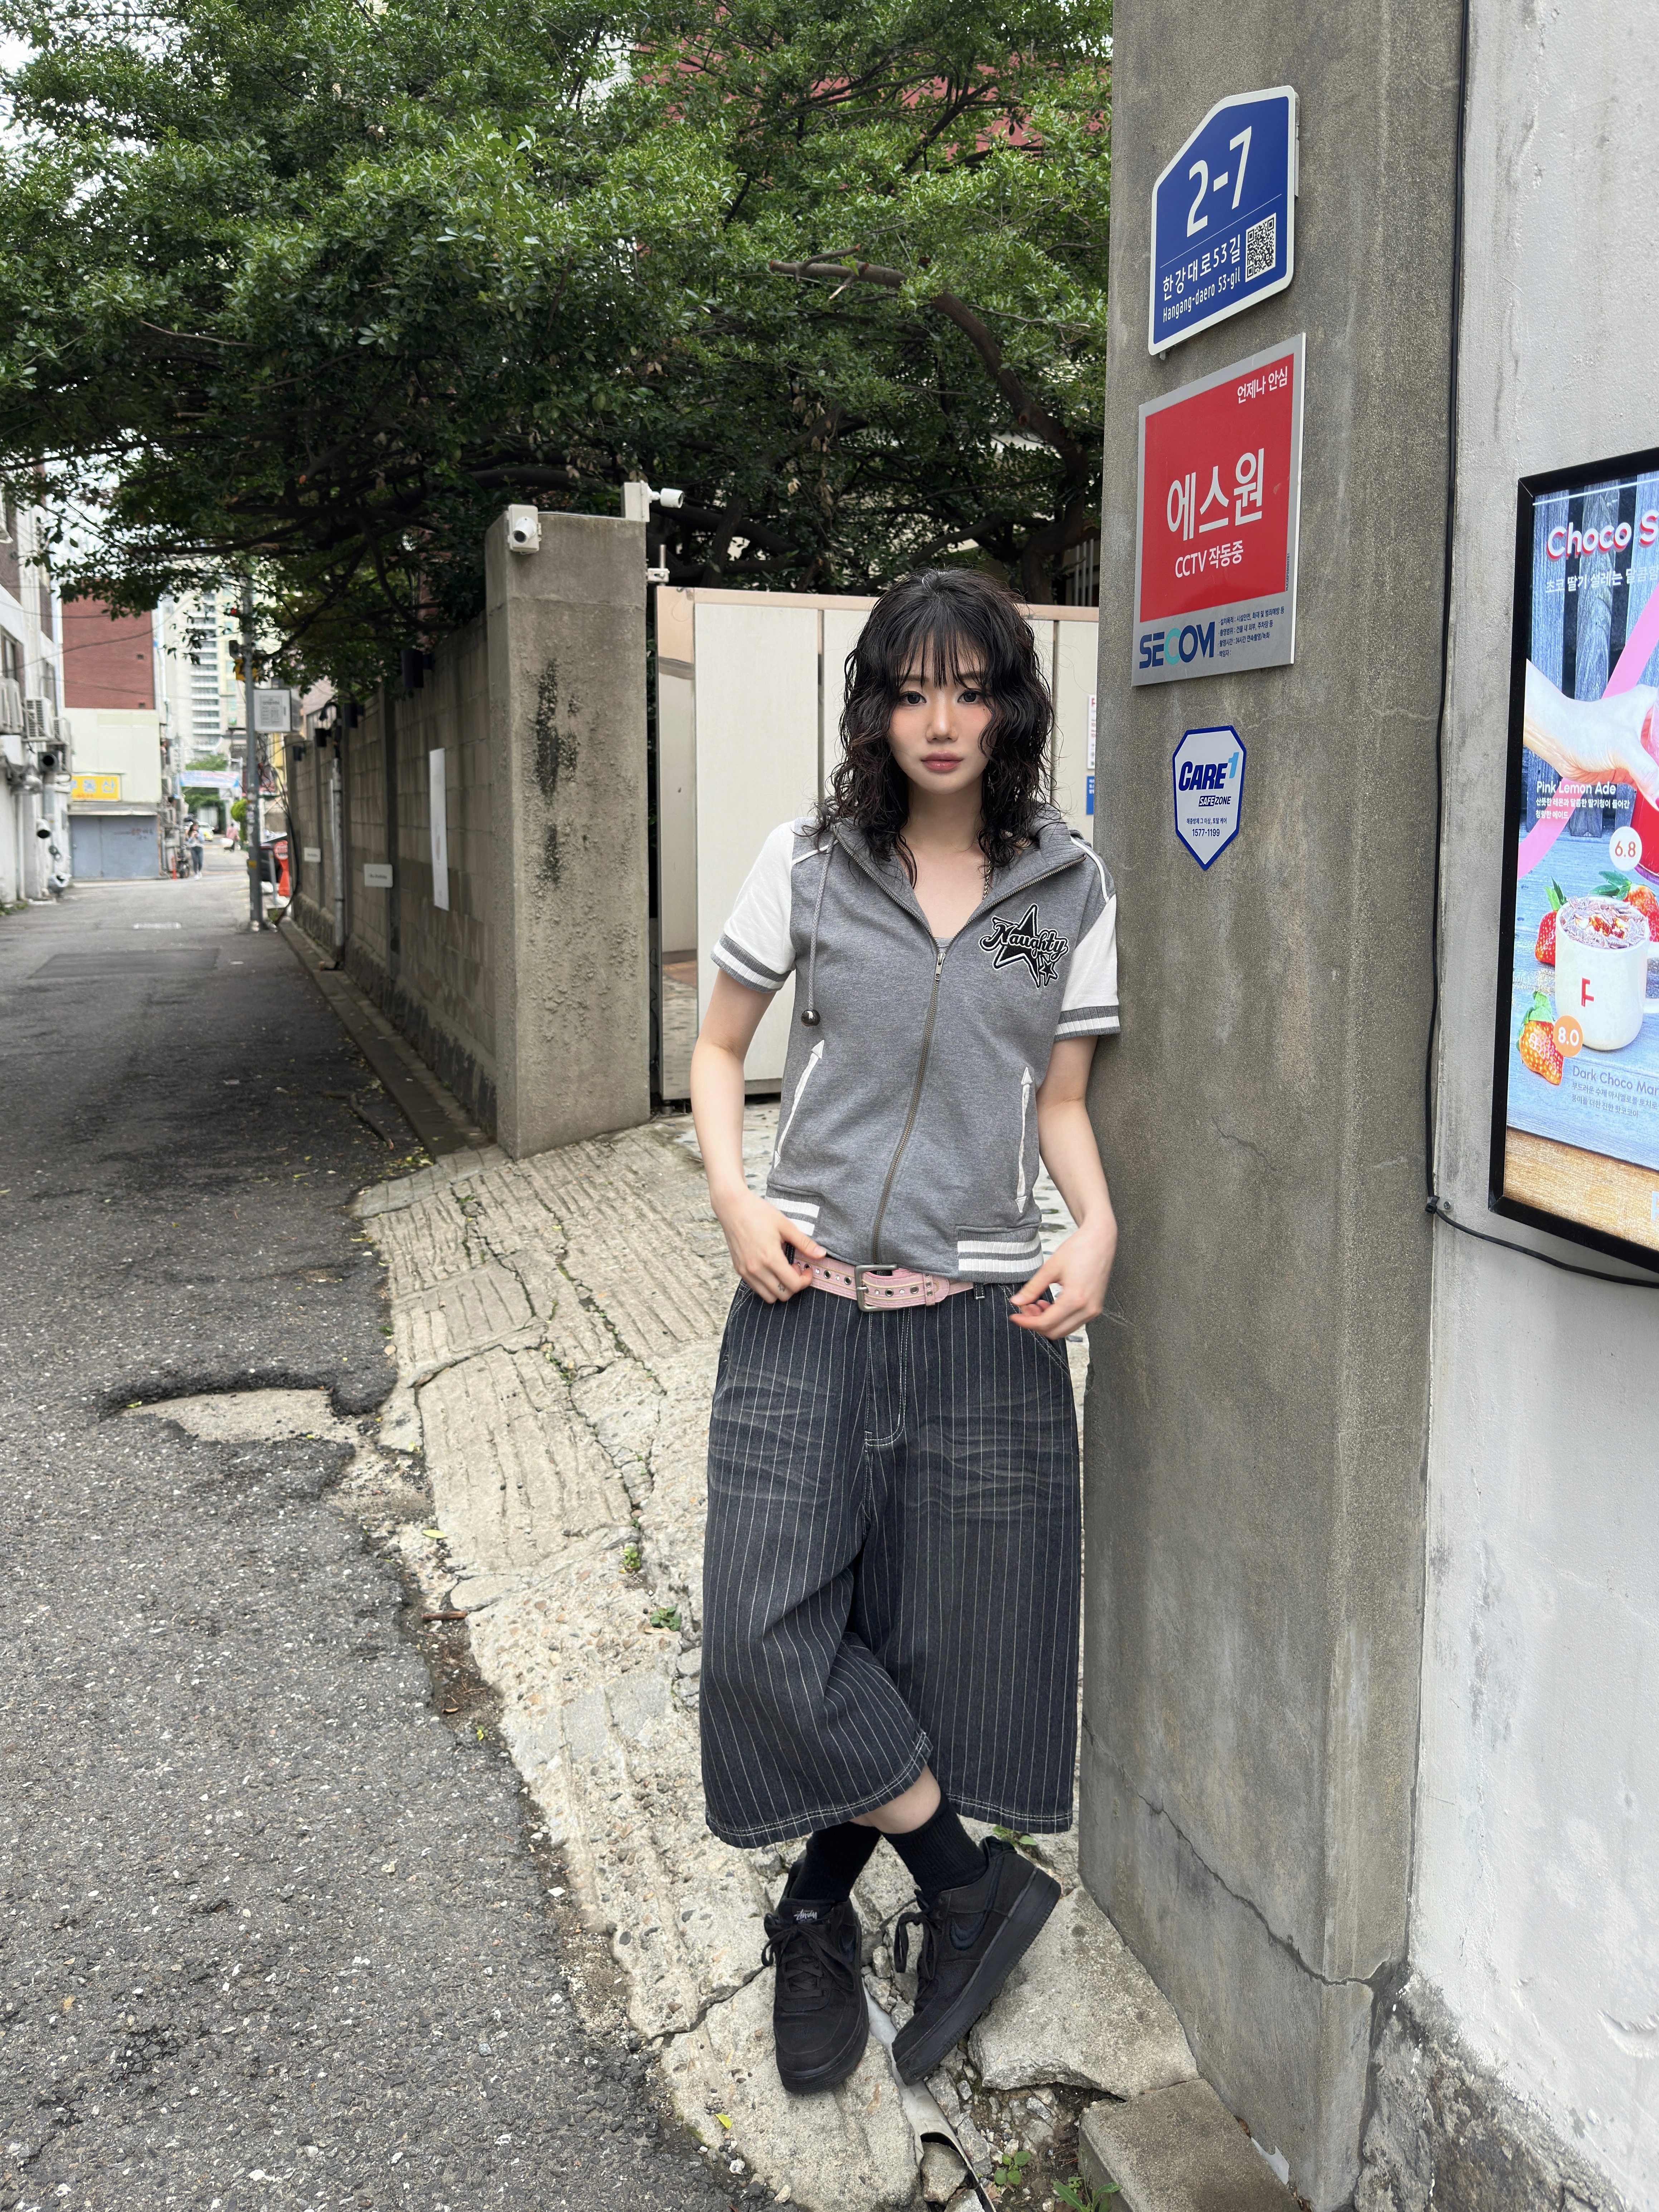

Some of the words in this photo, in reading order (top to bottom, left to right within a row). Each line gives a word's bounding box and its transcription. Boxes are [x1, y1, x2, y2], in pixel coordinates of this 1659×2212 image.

[1187, 126, 1252, 237] 2-7
[1163, 234, 1241, 302] 한강대로53길
[1163, 281, 1215, 323] Hangang-daero
[1218, 266, 1241, 293] 53-gil
[1237, 380, 1267, 404] 언제나
[1268, 366, 1288, 392] 안심
[1167, 448, 1265, 541] 에스원
[1546, 521, 1632, 561] Choco
[1175, 550, 1208, 578] CCTV
[1209, 540, 1244, 570] 작동중
[1545, 577, 1565, 593] 초코
[1567, 574, 1587, 592] 딸기
[1590, 570, 1623, 588] 설레는
[1139, 621, 1215, 669] SECOM
[1536, 781, 1556, 793] Pink
[1559, 781, 1592, 794] Lemon
[1594, 781, 1616, 795] Ade
[1535, 810, 1552, 819] 청량한
[1552, 810, 1569, 820] 에이드
[1536, 797, 1552, 807] 산뜻한
[1553, 798, 1569, 807] 레몬과
[1570, 798, 1587, 808] 달콤한
[1612, 799, 1630, 809] 들어간
[1192, 828, 1220, 837] 1577-1199
[1615, 840, 1636, 858] 6.8
[979, 922, 1069, 961] Naughty
[1558, 1026, 1579, 1046] 8.0
[1572, 1065, 1596, 1081] Dark
[1600, 1072, 1633, 1090] Choco
[1571, 1094, 1588, 1105] 풍미를
[1590, 1099, 1601, 1109] 더한
[1602, 1102, 1614, 1112] 진한
[1615, 1105, 1639, 1119] 핫코코아
[1572, 1081, 1595, 1094] 부드러운
[1595, 1088, 1607, 1098] 수제
[1639, 1098, 1658, 1110] 토치로
